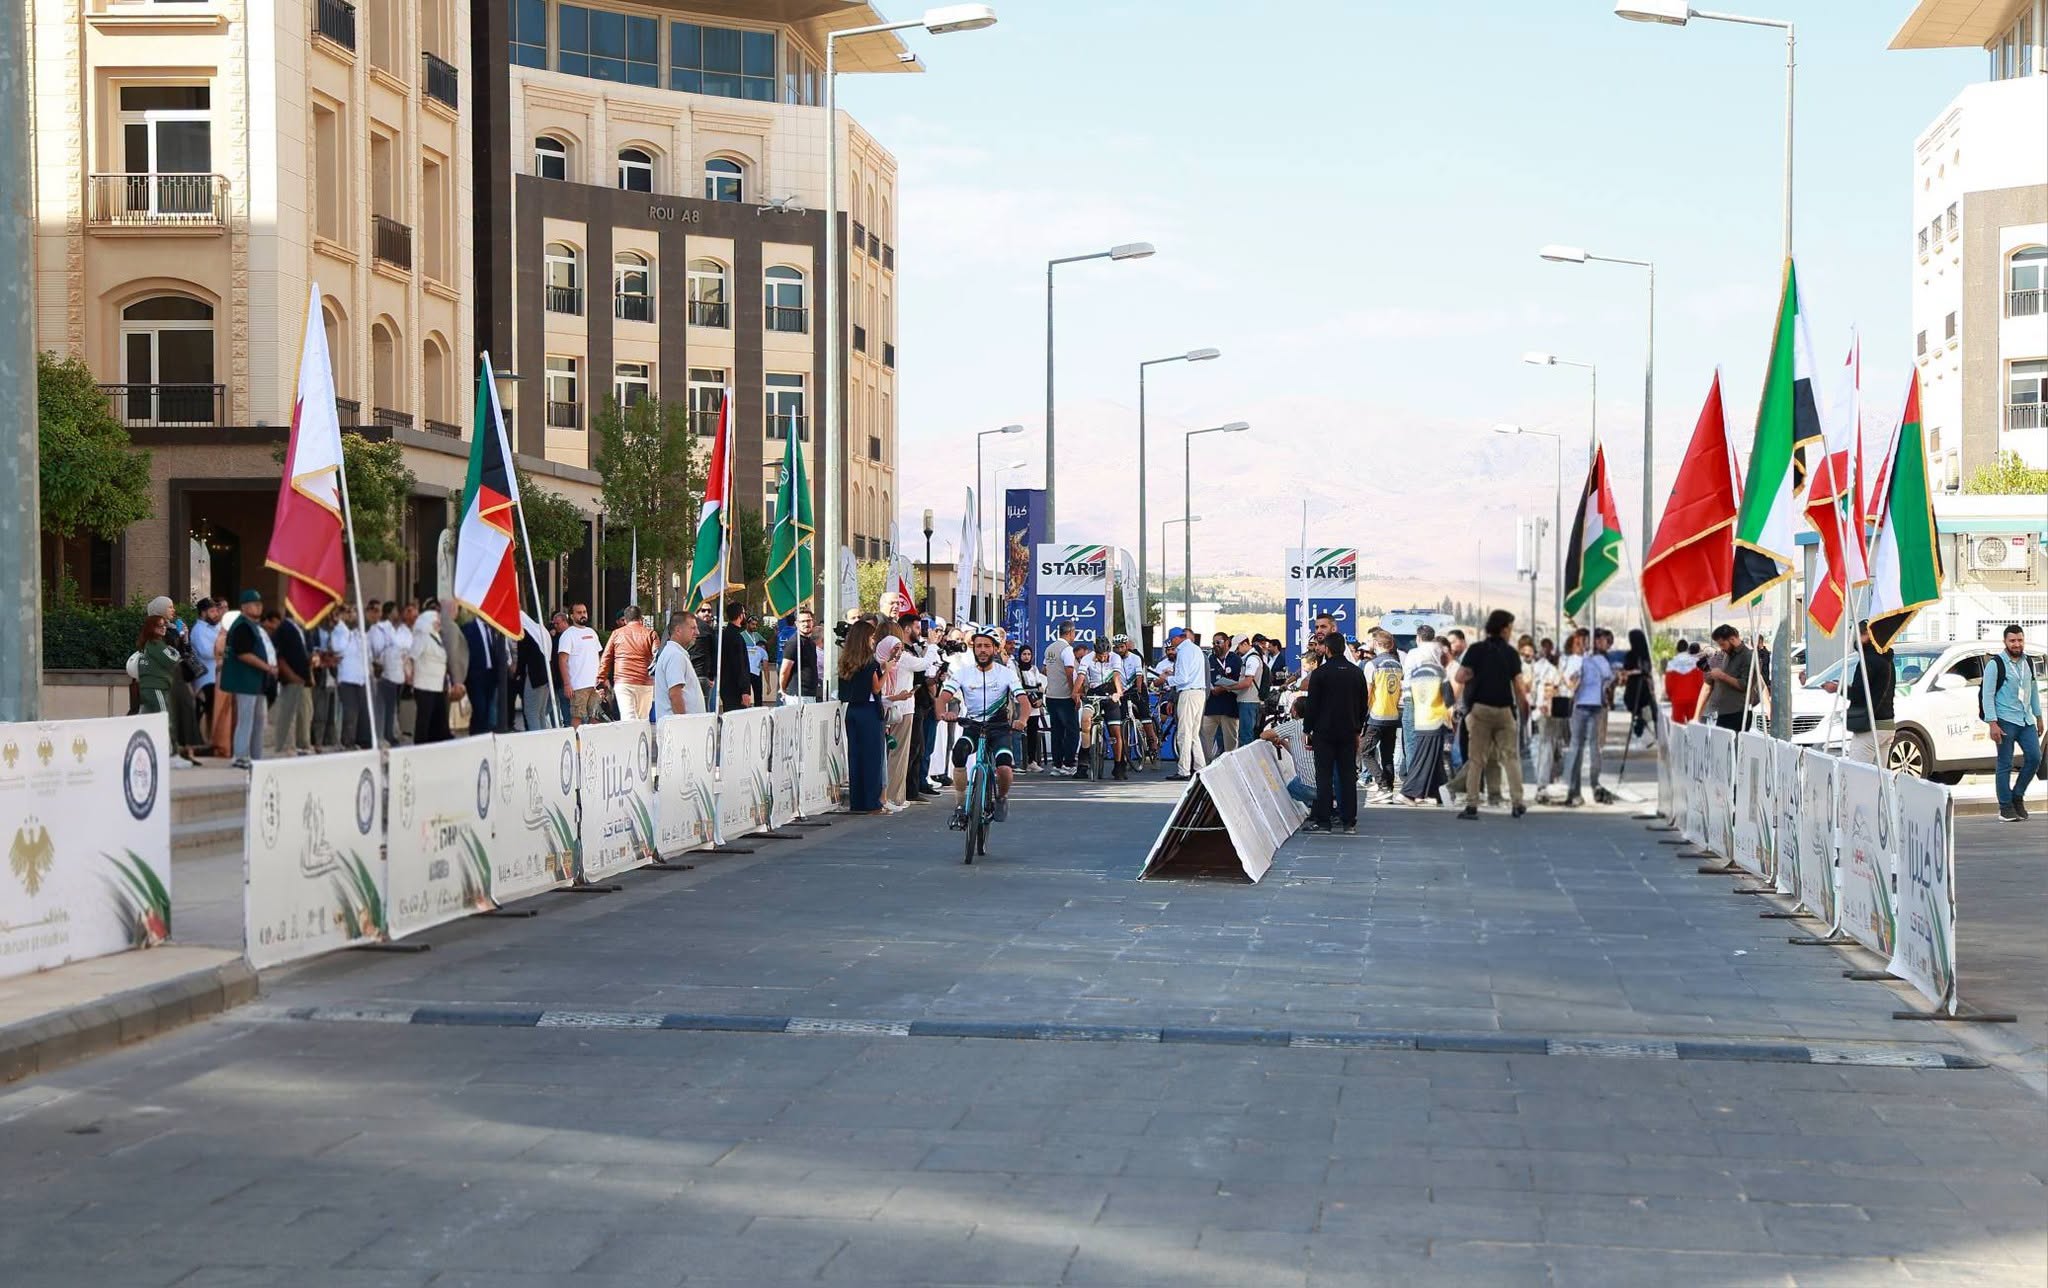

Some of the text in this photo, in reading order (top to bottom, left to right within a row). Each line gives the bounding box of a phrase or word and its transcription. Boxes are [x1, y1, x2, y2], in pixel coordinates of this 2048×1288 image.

[649, 206, 700, 223] ROU A8
[1007, 505, 1028, 518] كينزا
[1041, 562, 1101, 576] START
[1045, 600, 1097, 622] كينزا
[1045, 625, 1097, 643] kiza
[602, 750, 633, 813] كينزا
